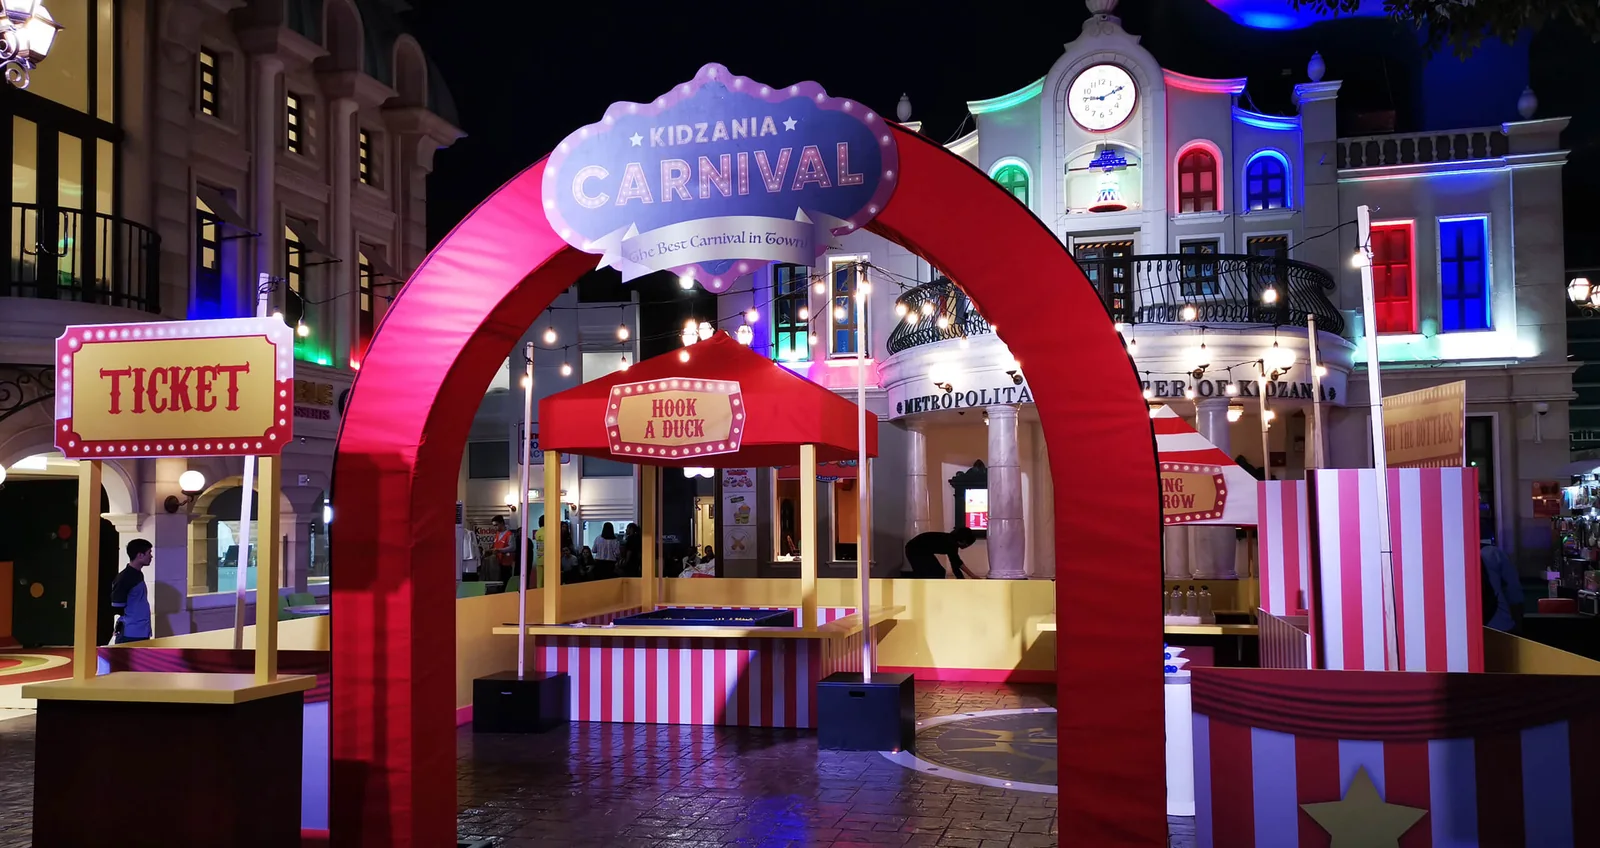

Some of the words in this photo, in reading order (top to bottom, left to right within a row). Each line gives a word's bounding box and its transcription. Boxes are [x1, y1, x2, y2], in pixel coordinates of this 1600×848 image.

[1085, 104, 1090, 112] 8
[649, 115, 778, 148] KIDZANIA
[571, 141, 864, 210] CARNIVAL
[630, 247, 655, 263] The
[657, 240, 687, 255] Best
[690, 231, 745, 248] Carnival
[749, 231, 761, 244] in
[99, 361, 250, 415] TICKET
[904, 386, 1032, 415] METROPOLITA
[1199, 379, 1229, 397] OF
[1238, 380, 1327, 401] KIDZANA
[652, 398, 697, 418] HOOK
[644, 420, 655, 439] A
[662, 419, 705, 439] DUCK
[1399, 420, 1414, 450] THE
[1416, 411, 1453, 448] BOTTLES
